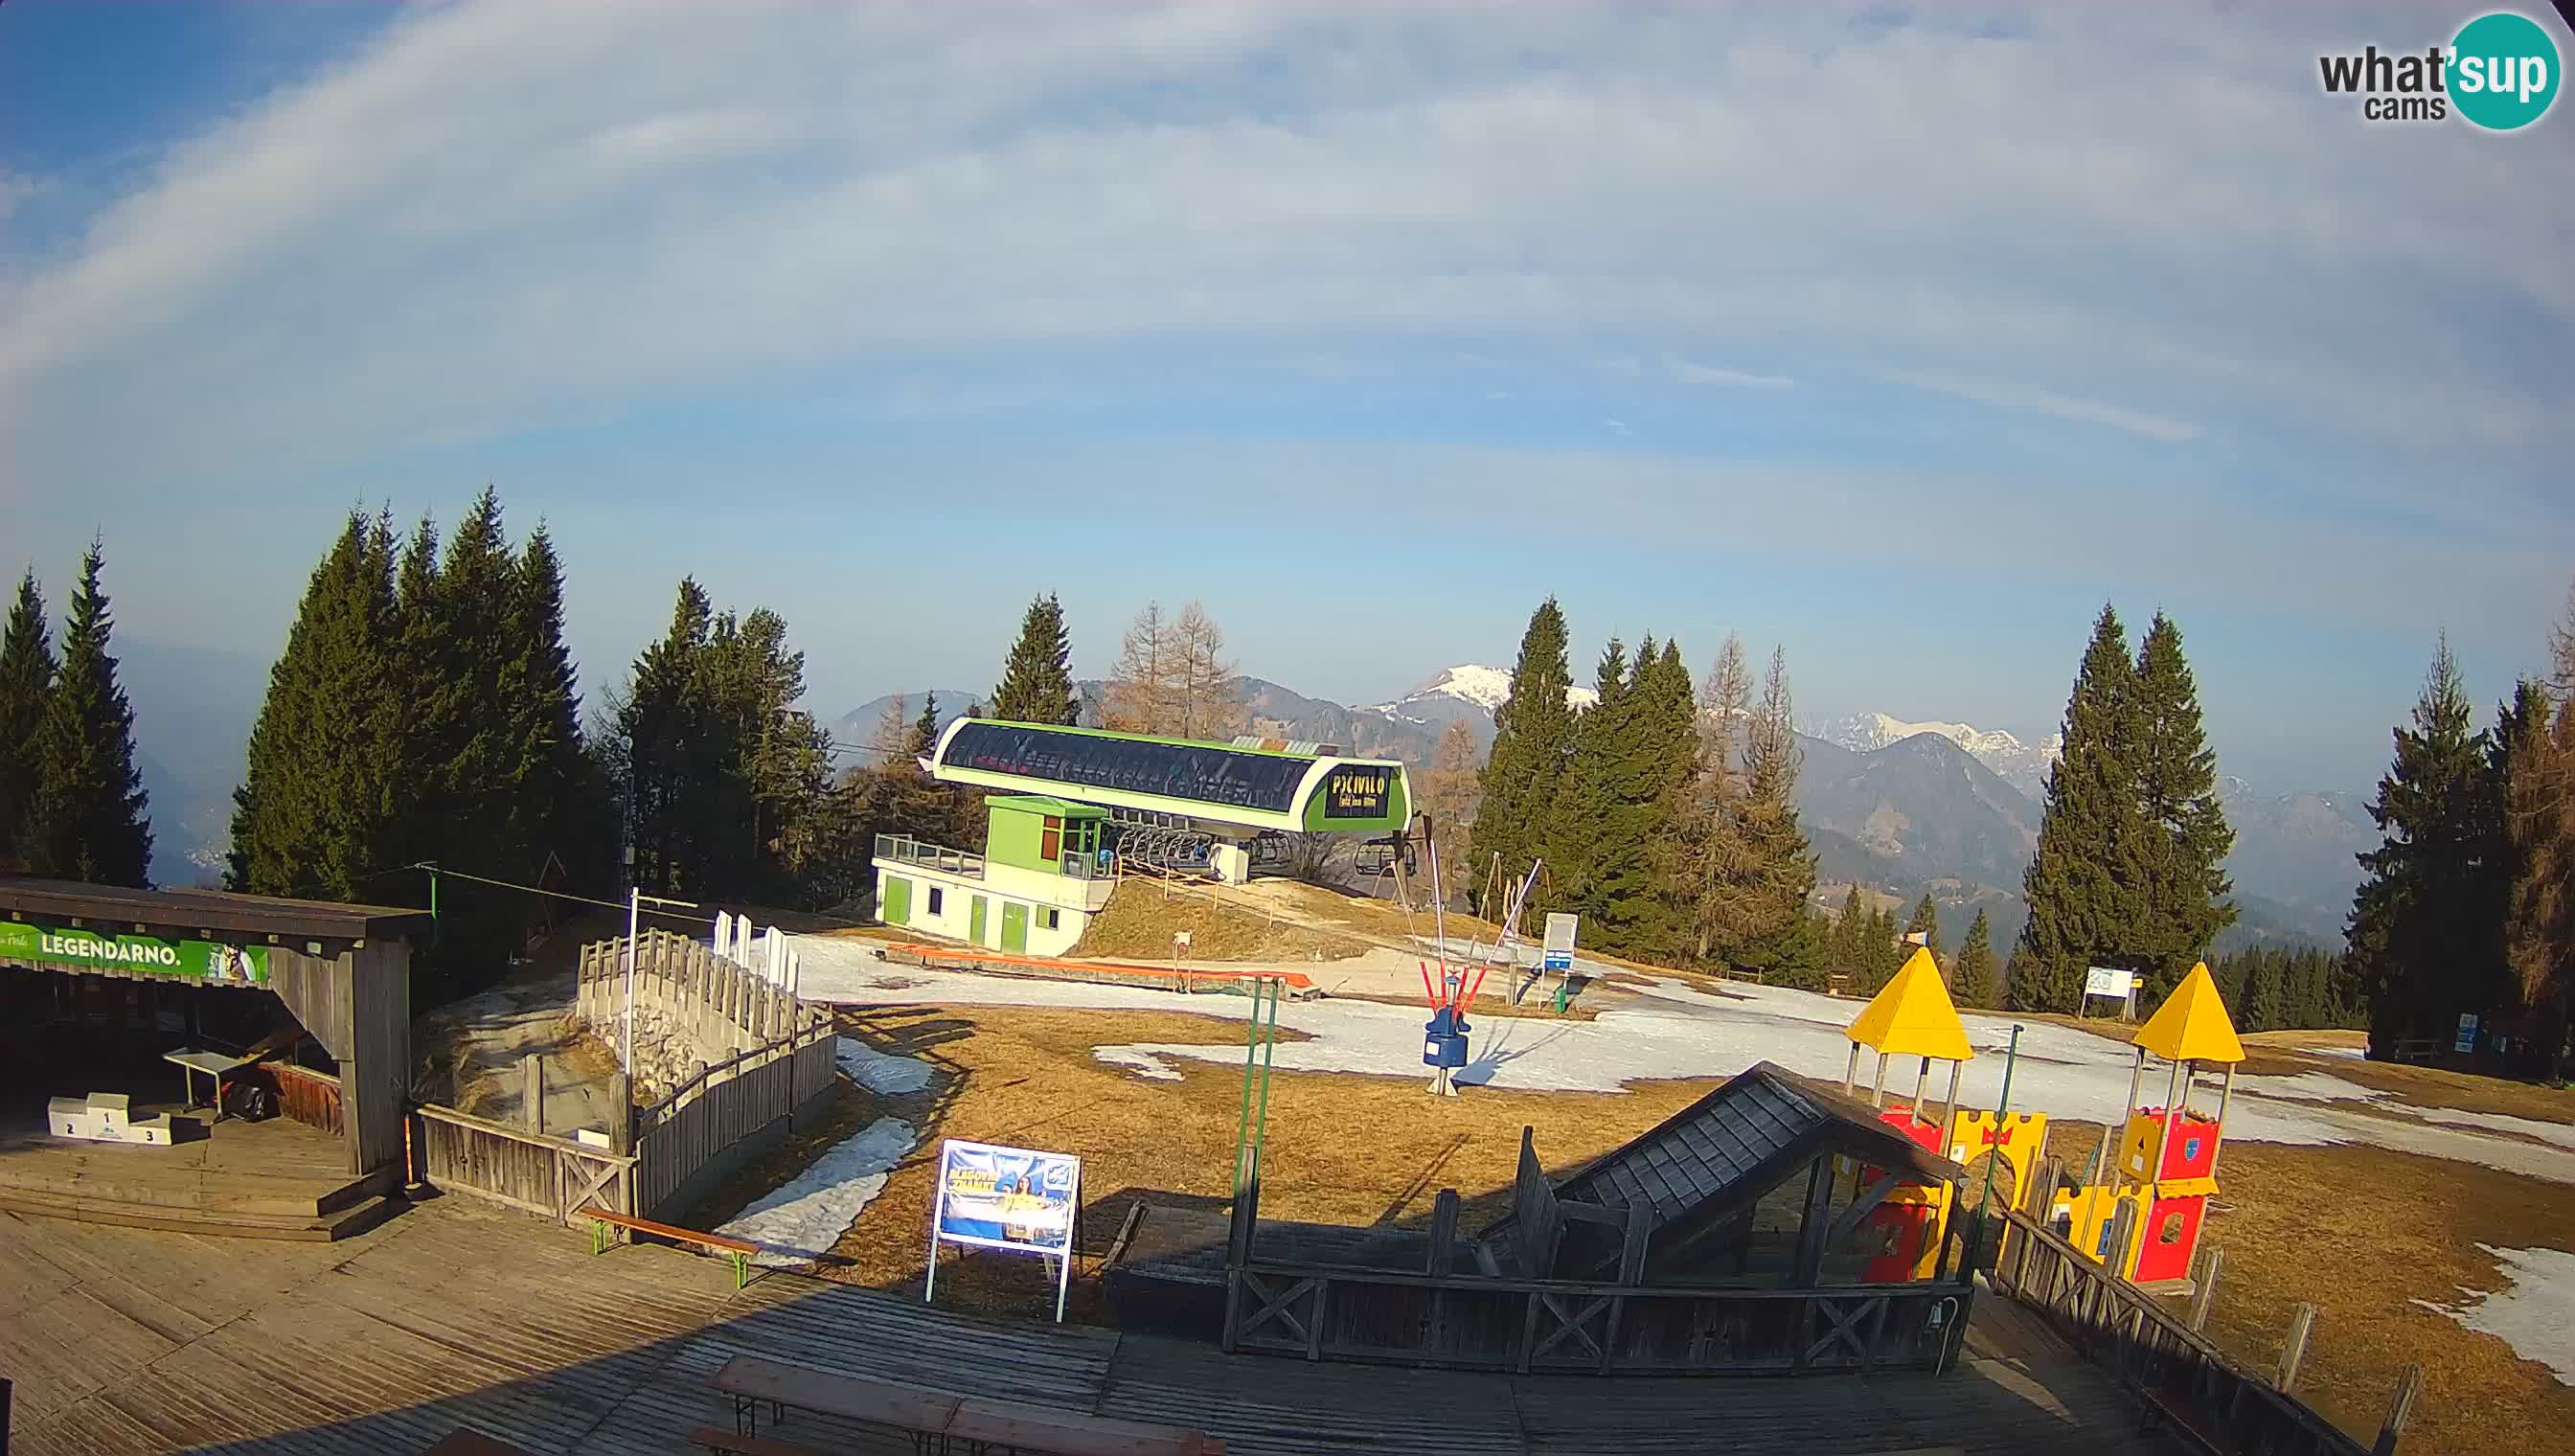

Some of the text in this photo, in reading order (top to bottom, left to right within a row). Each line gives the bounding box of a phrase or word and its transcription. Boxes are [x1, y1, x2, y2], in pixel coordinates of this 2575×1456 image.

[40, 933, 182, 967] LEGENDARNO.
[104, 1112, 109, 1123] 1
[66, 1124, 75, 1135] 2
[146, 1130, 154, 1142] 3
